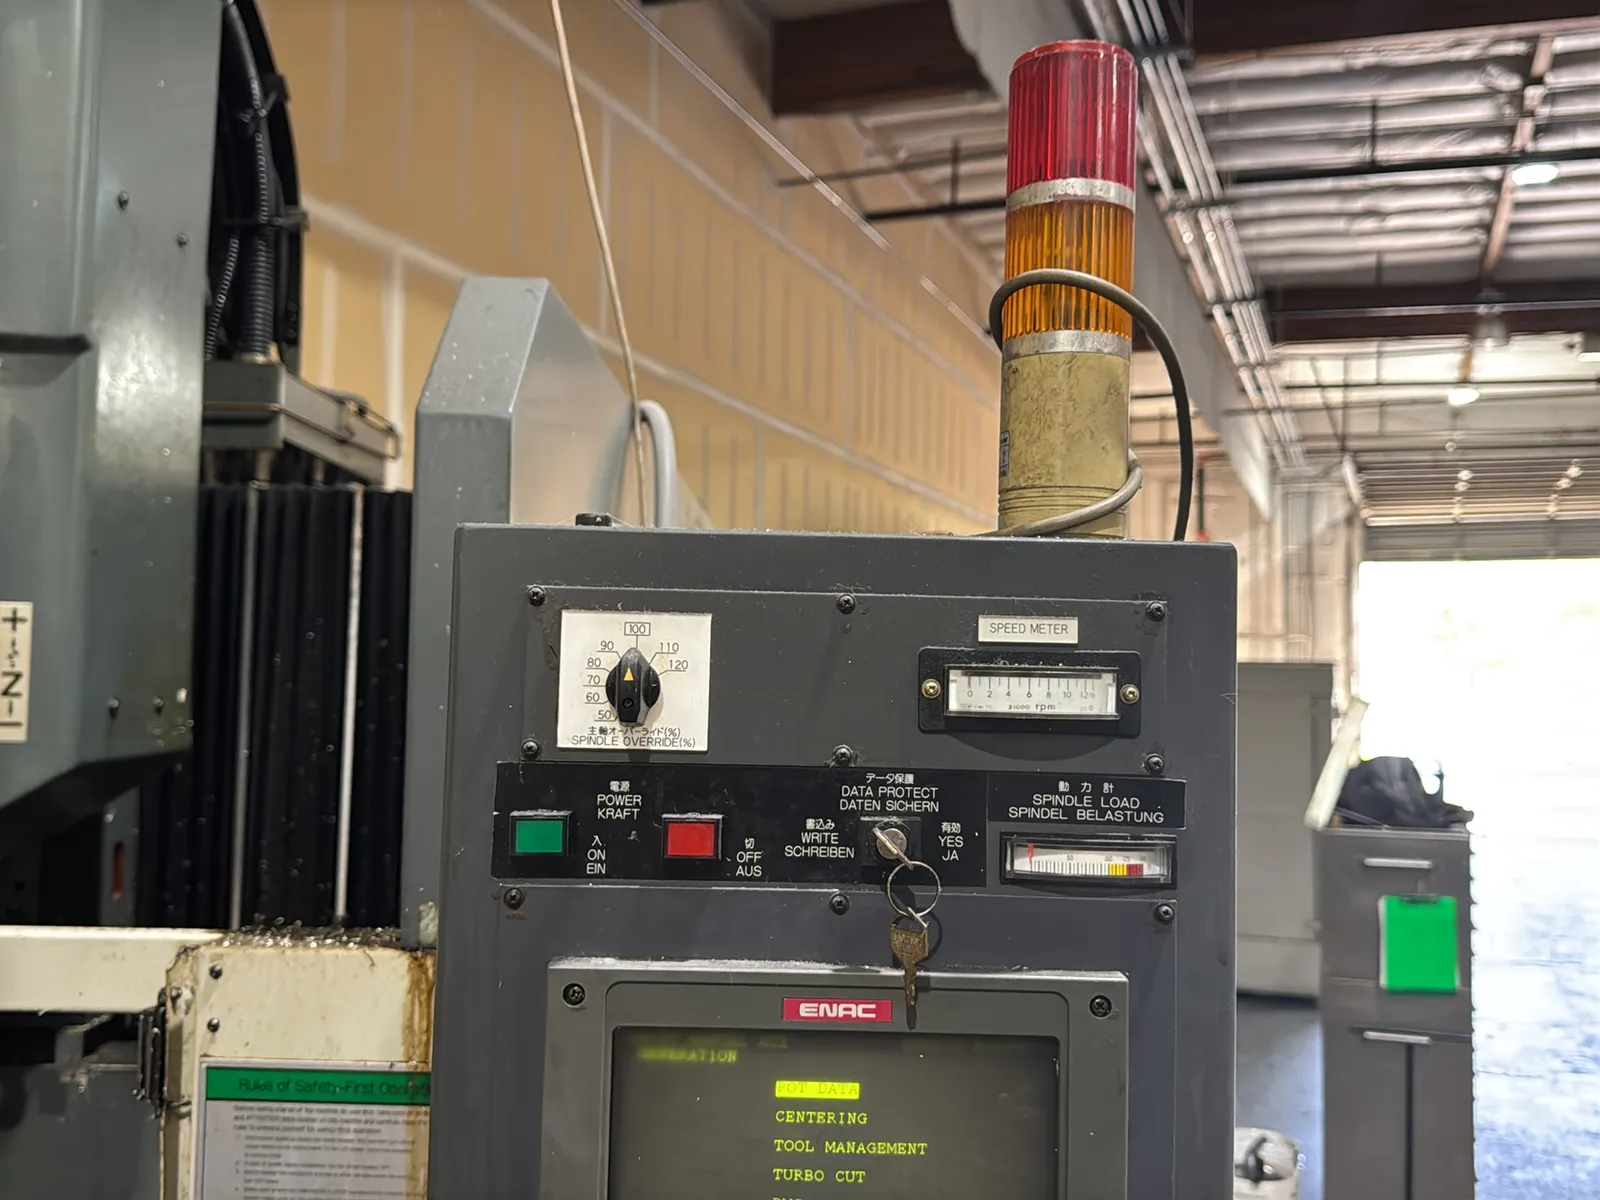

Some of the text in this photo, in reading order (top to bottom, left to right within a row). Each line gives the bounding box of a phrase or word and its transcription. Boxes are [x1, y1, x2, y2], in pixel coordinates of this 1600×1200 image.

[628, 624, 646, 634] 100
[989, 622, 1069, 635] SPEED METER
[600, 641, 614, 651] 90
[660, 642, 680, 652] 110
[587, 658, 601, 667] 80
[669, 660, 689, 669] 120
[587, 675, 600, 684] 70
[586, 692, 600, 702] 60
[967, 690, 973, 698] 0
[987, 690, 993, 698] 2
[1026, 690, 1032, 699] 6
[1046, 691, 1052, 699] 8
[1063, 690, 1072, 699] 10
[1035, 703, 1056, 712] rpm
[597, 710, 612, 720] 50
[571, 735, 696, 748] SPINDLE OVERRIDE(%)
[609, 780, 630, 792] 電源
[841, 785, 938, 799] DATA PROTECT
[597, 794, 642, 806] POWER
[839, 799, 939, 812] DATEN SICHERN
[1032, 794, 1140, 809] SPINDLE LOAD
[597, 808, 640, 820] KRAFT
[1008, 806, 1164, 824] SPINDEL BELASTUNG
[806, 818, 836, 830] 書込み
[744, 838, 755, 849] 切
[801, 832, 839, 844] WRITE
[938, 835, 964, 847] YES
[587, 849, 606, 861] ON
[736, 851, 762, 863] OFF
[784, 845, 855, 858] SCHREIBEN
[941, 850, 959, 861] JA
[586, 863, 606, 874] EIN
[736, 865, 762, 877] AUS
[799, 1003, 876, 1018] ENAC
[239, 1078, 274, 1092] Rules
[277, 1079, 292, 1092] of
[295, 1079, 375, 1096] Safety-First
[777, 1081, 858, 1095] POT DATA
[775, 1110, 868, 1125] CENTERING
[773, 1139, 928, 1155] TOOL MANAGEMENT
[772, 1168, 866, 1183] TURBO CUT
